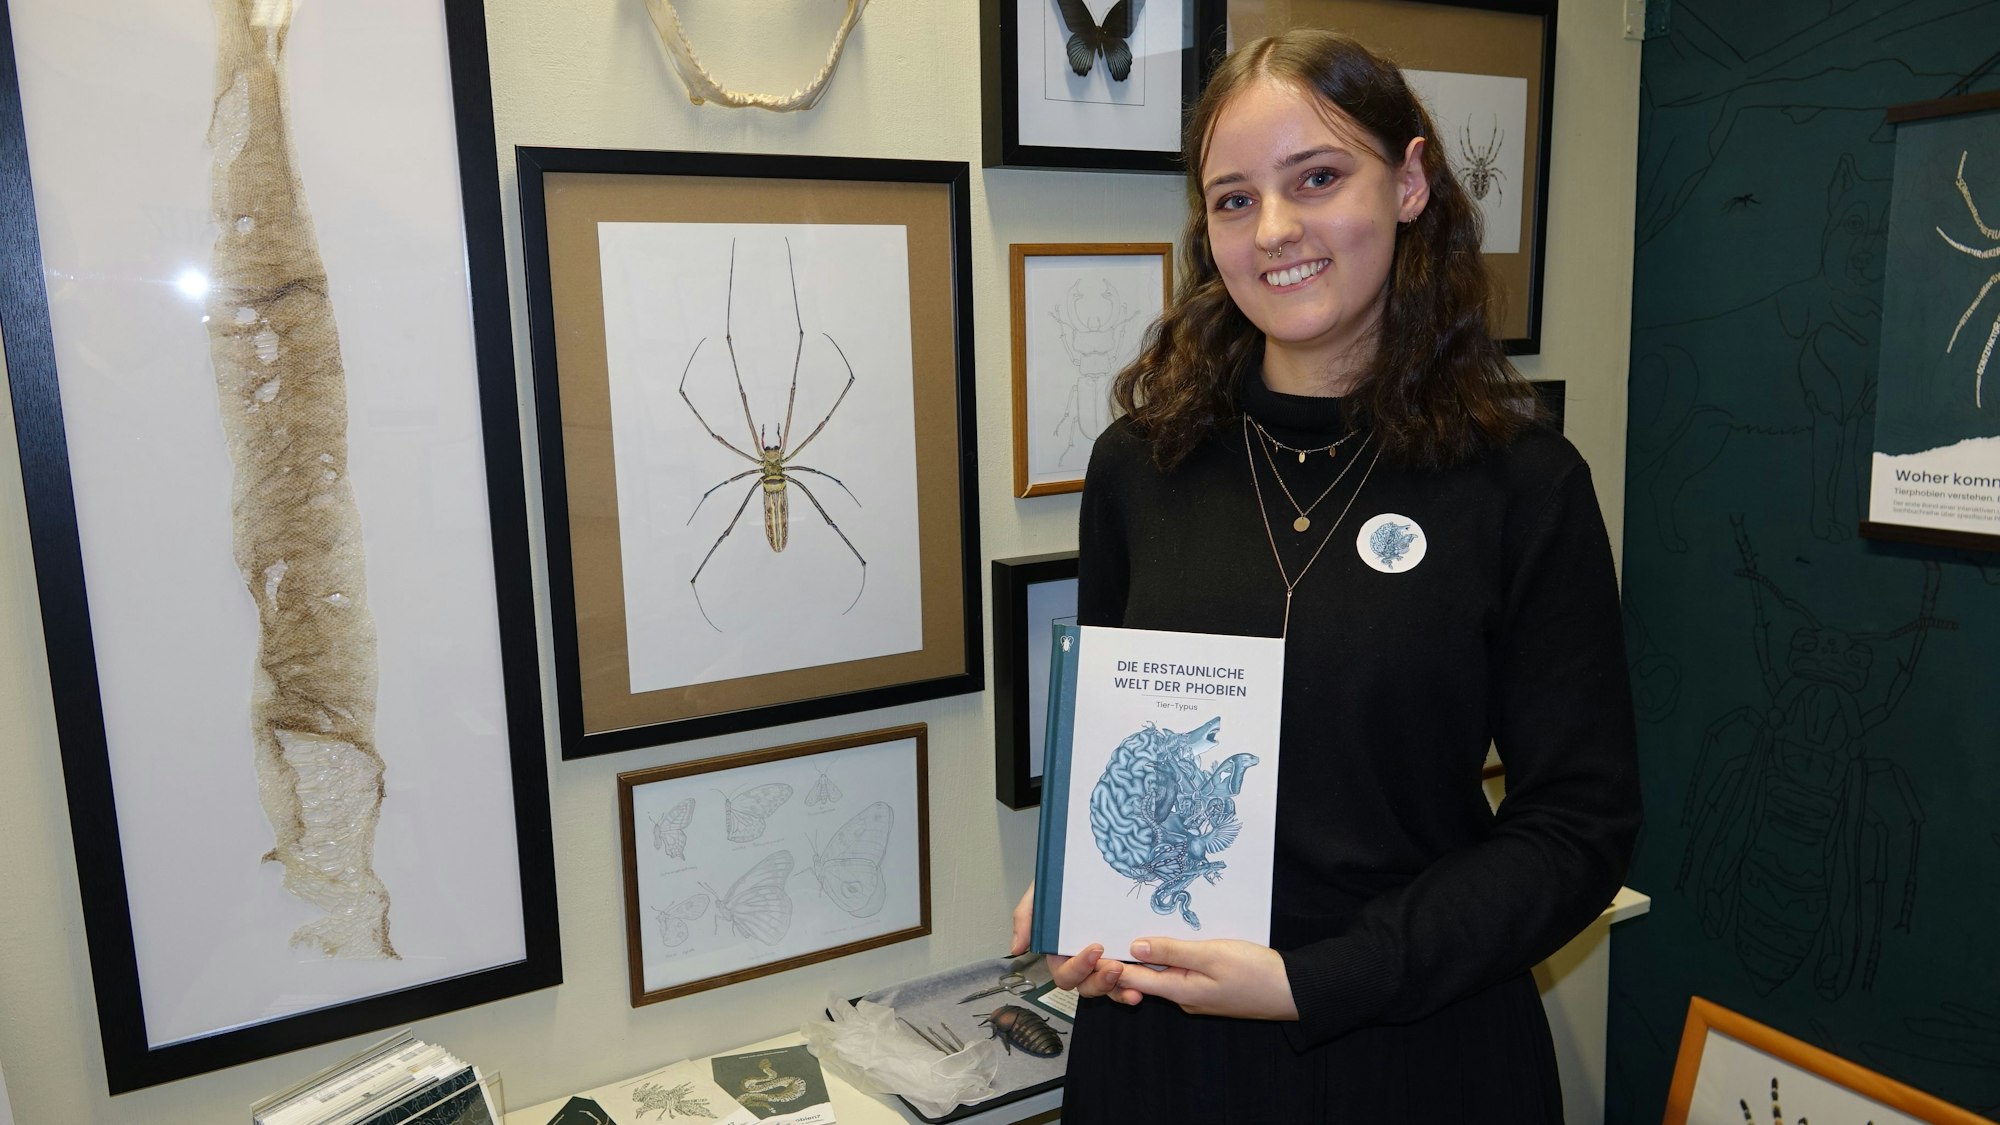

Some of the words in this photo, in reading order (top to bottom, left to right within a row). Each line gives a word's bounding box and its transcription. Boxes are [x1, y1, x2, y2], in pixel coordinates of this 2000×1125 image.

[1895, 469, 1949, 485] Woher
[1894, 487, 1946, 499] Tierphobien
[1947, 492, 1995, 502] verstehen.
[1117, 660, 1138, 673] DIE
[1143, 662, 1245, 680] ERSTAUNLICHE
[1114, 677, 1149, 690] WELT
[1154, 680, 1180, 692] DER
[1185, 682, 1247, 697] PHOBIEN
[1156, 701, 1199, 712] Tier-Typus
